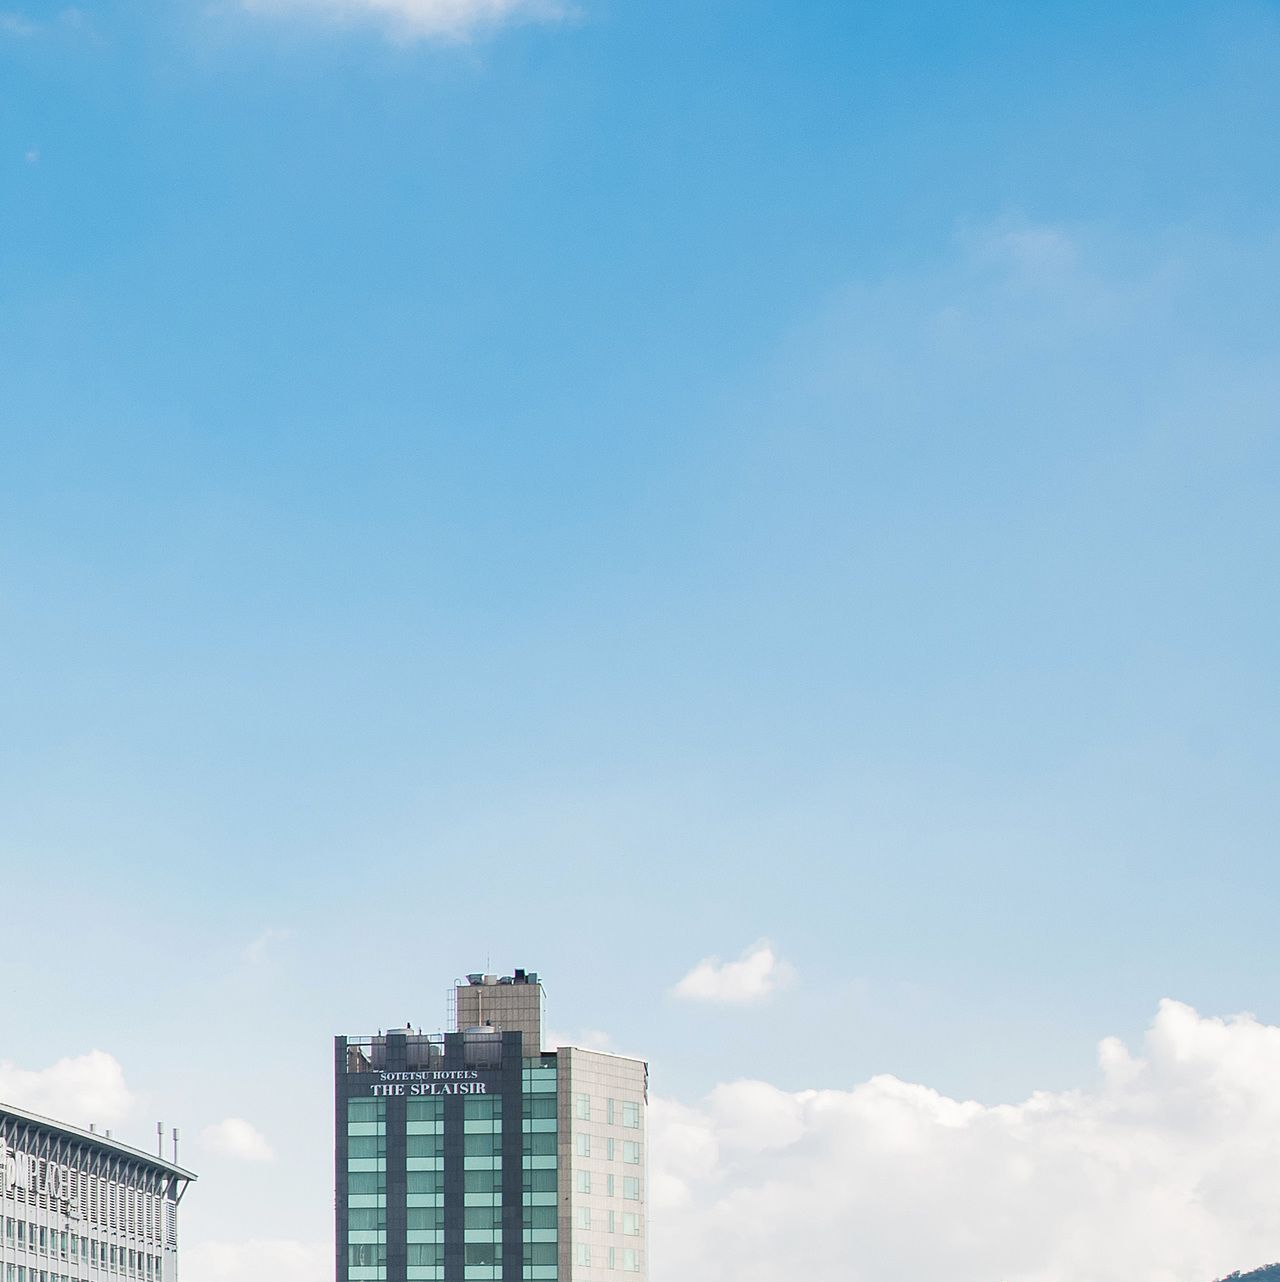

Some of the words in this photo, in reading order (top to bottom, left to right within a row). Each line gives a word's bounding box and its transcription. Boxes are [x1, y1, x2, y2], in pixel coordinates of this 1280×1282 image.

[380, 1071, 429, 1081] SOTETSU
[433, 1070, 478, 1080] HOTELS
[370, 1084, 405, 1096] THE
[410, 1082, 487, 1095] SPLAISIR
